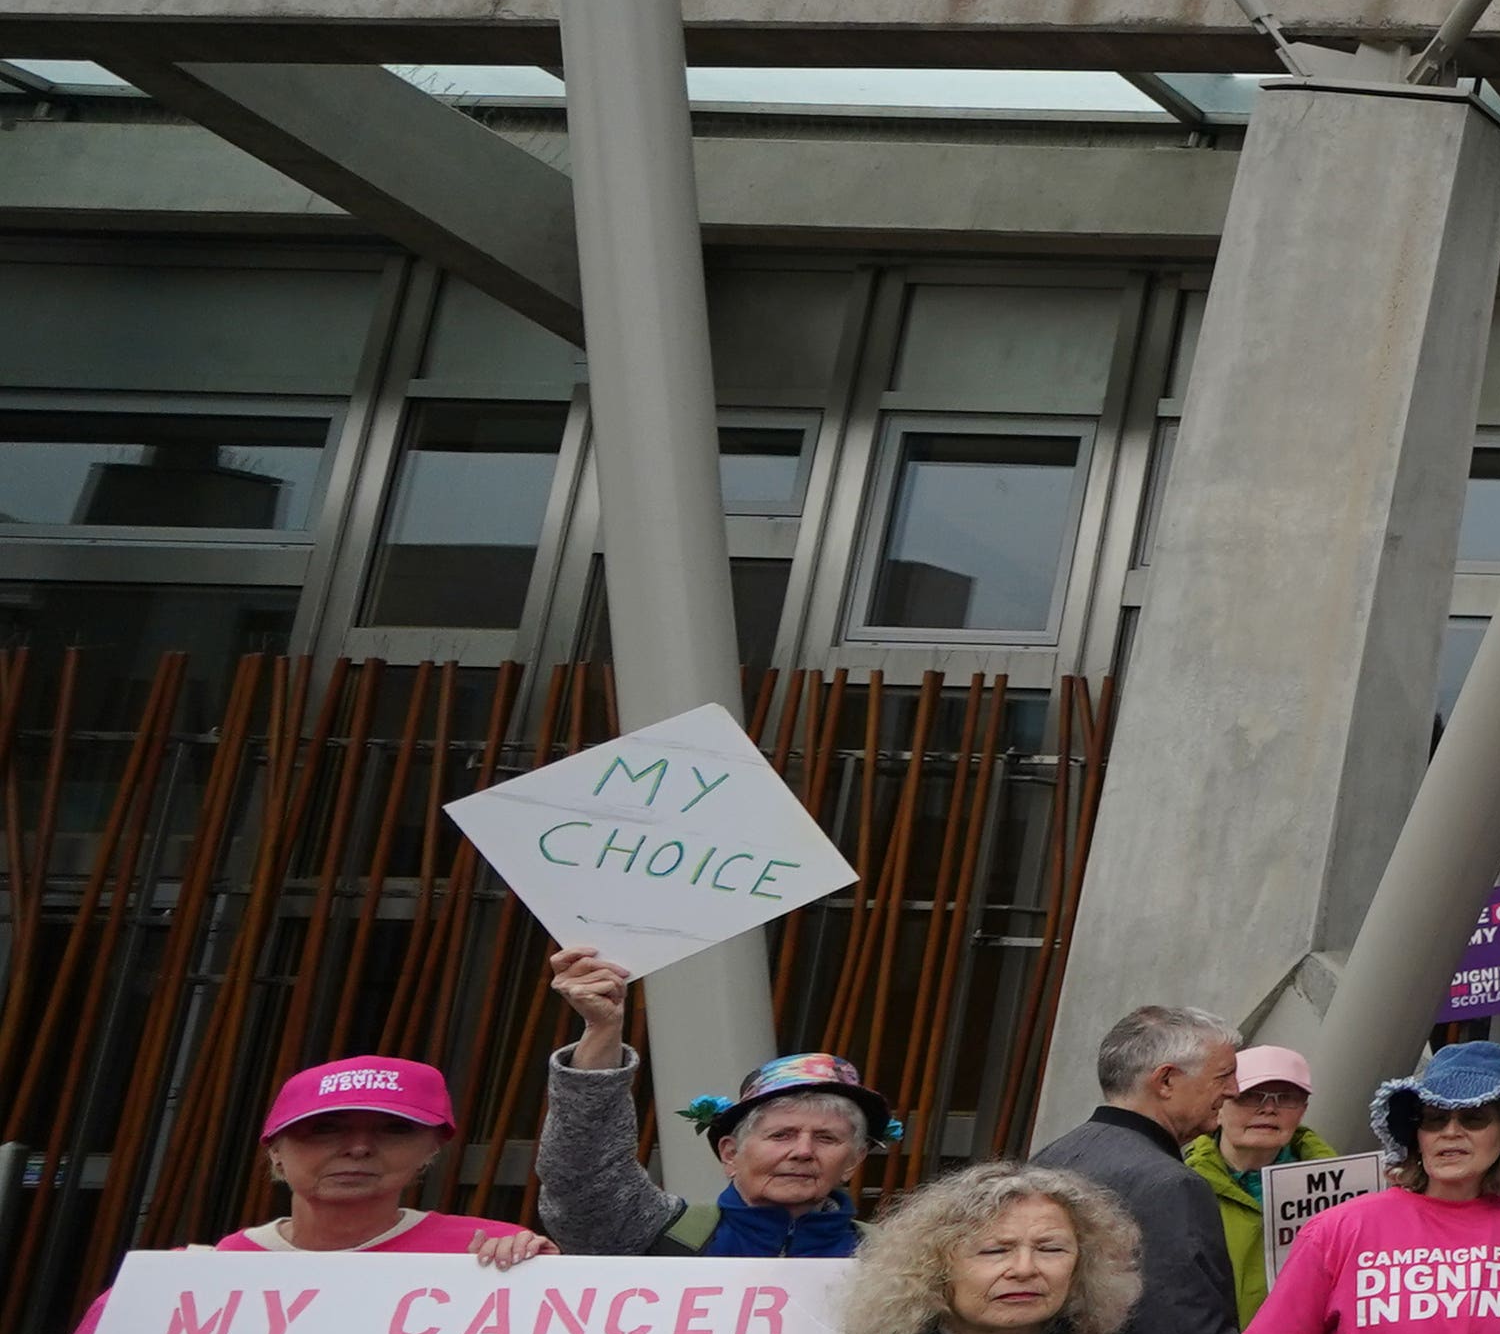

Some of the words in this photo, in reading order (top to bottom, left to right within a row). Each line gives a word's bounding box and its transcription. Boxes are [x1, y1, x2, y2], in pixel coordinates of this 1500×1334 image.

[591, 755, 730, 814] MY
[538, 819, 801, 901] CHOICE
[1306, 1169, 1345, 1195] MY
[1356, 1245, 1488, 1268] CAMPAIGN
[1356, 1298, 1401, 1328] IN
